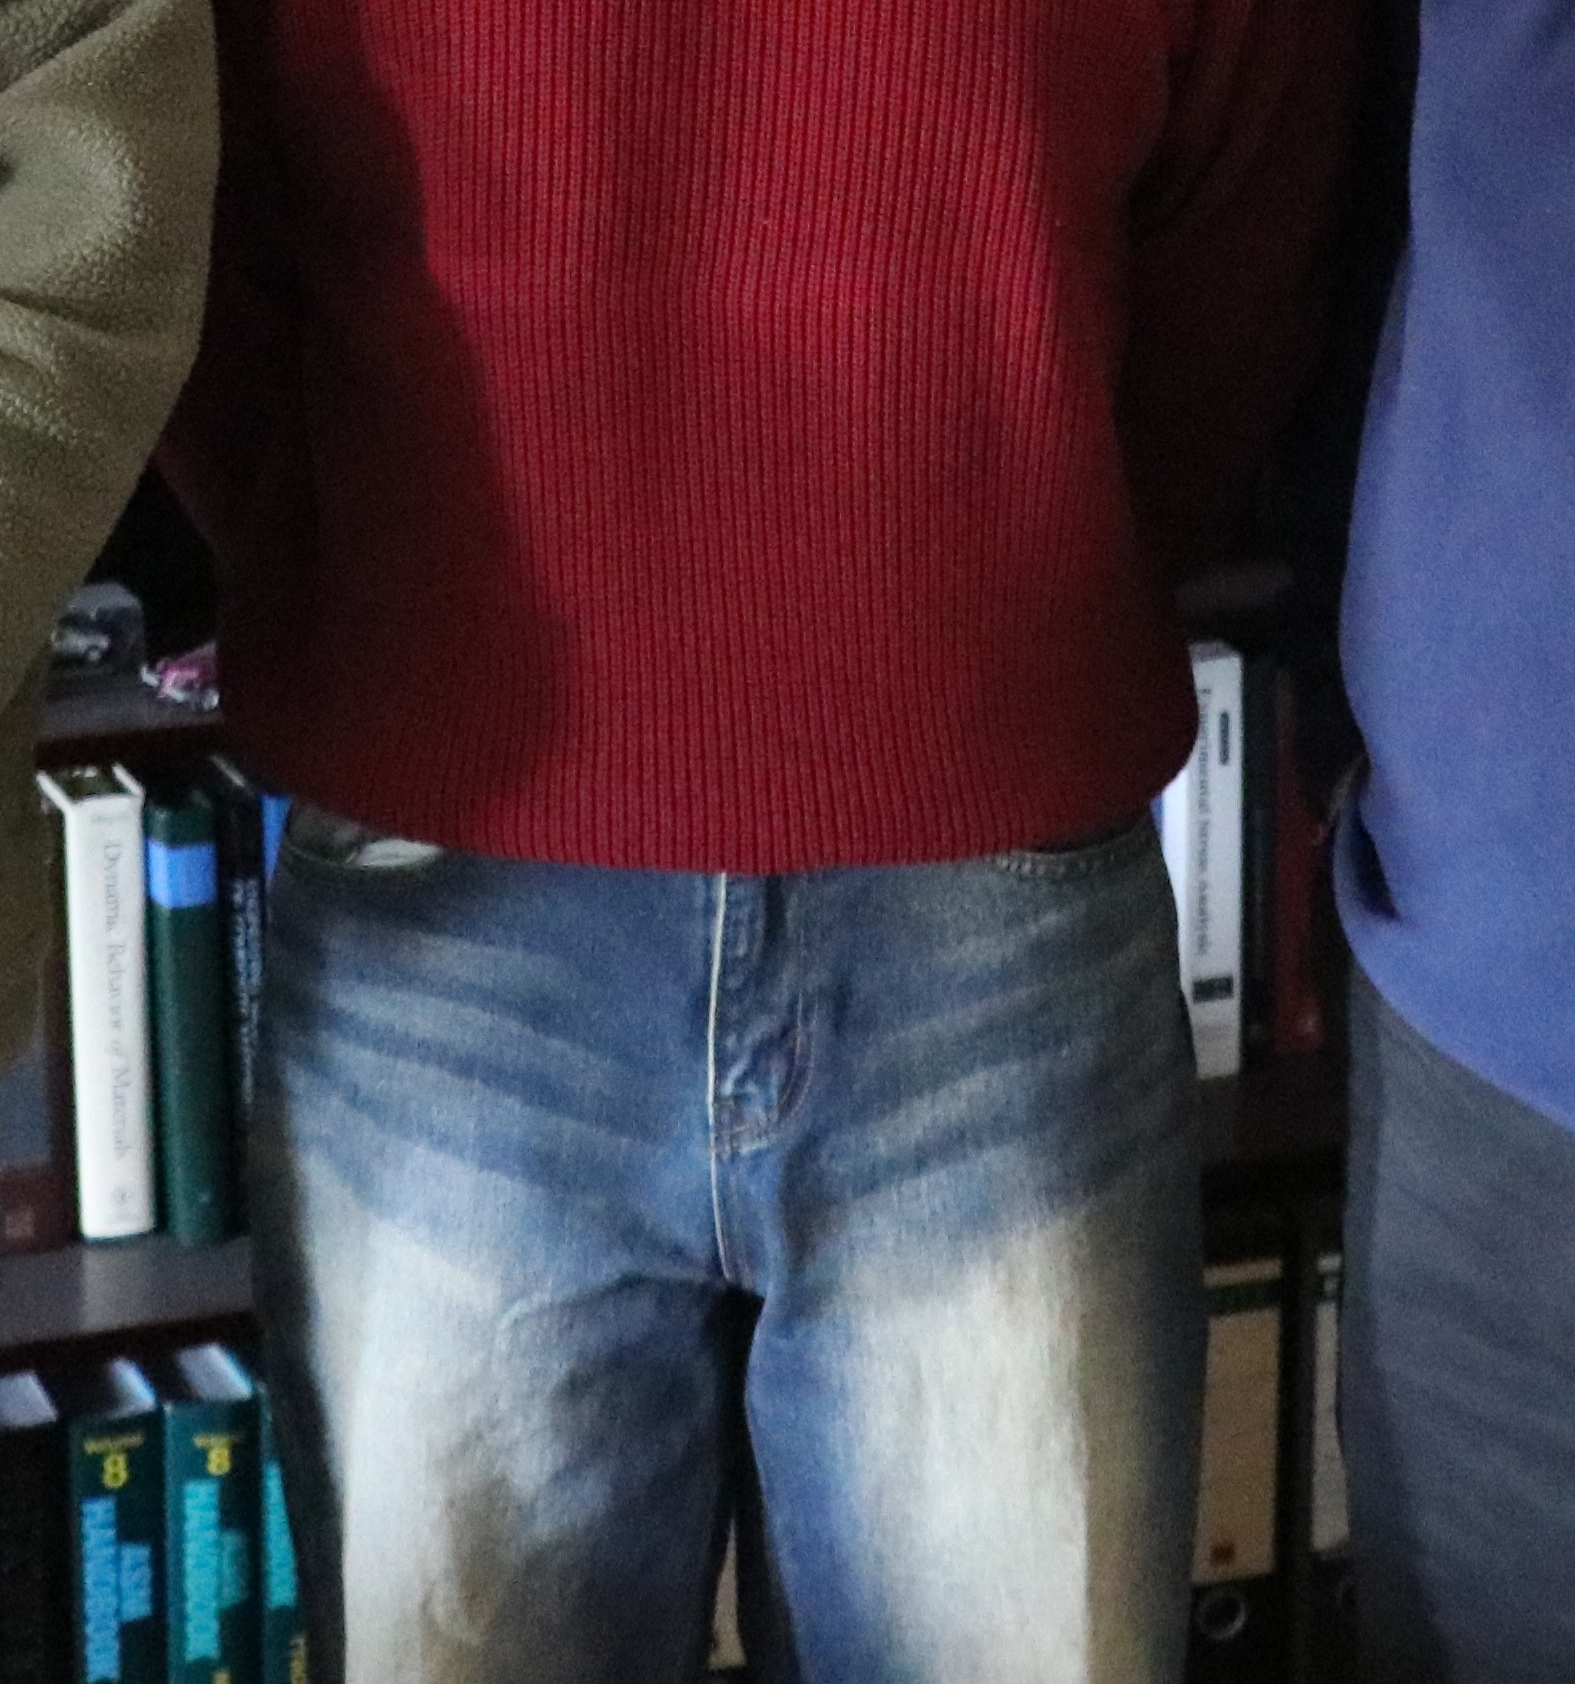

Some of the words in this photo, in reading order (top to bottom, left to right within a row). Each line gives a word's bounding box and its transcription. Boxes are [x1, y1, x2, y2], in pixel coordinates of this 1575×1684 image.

[103, 842, 123, 932] Dynamic
[106, 943, 126, 1031] Behavior
[109, 1039, 126, 1060] of
[112, 1067, 132, 1161] Materials
[102, 1454, 128, 1489] 8
[208, 1448, 231, 1475] 8
